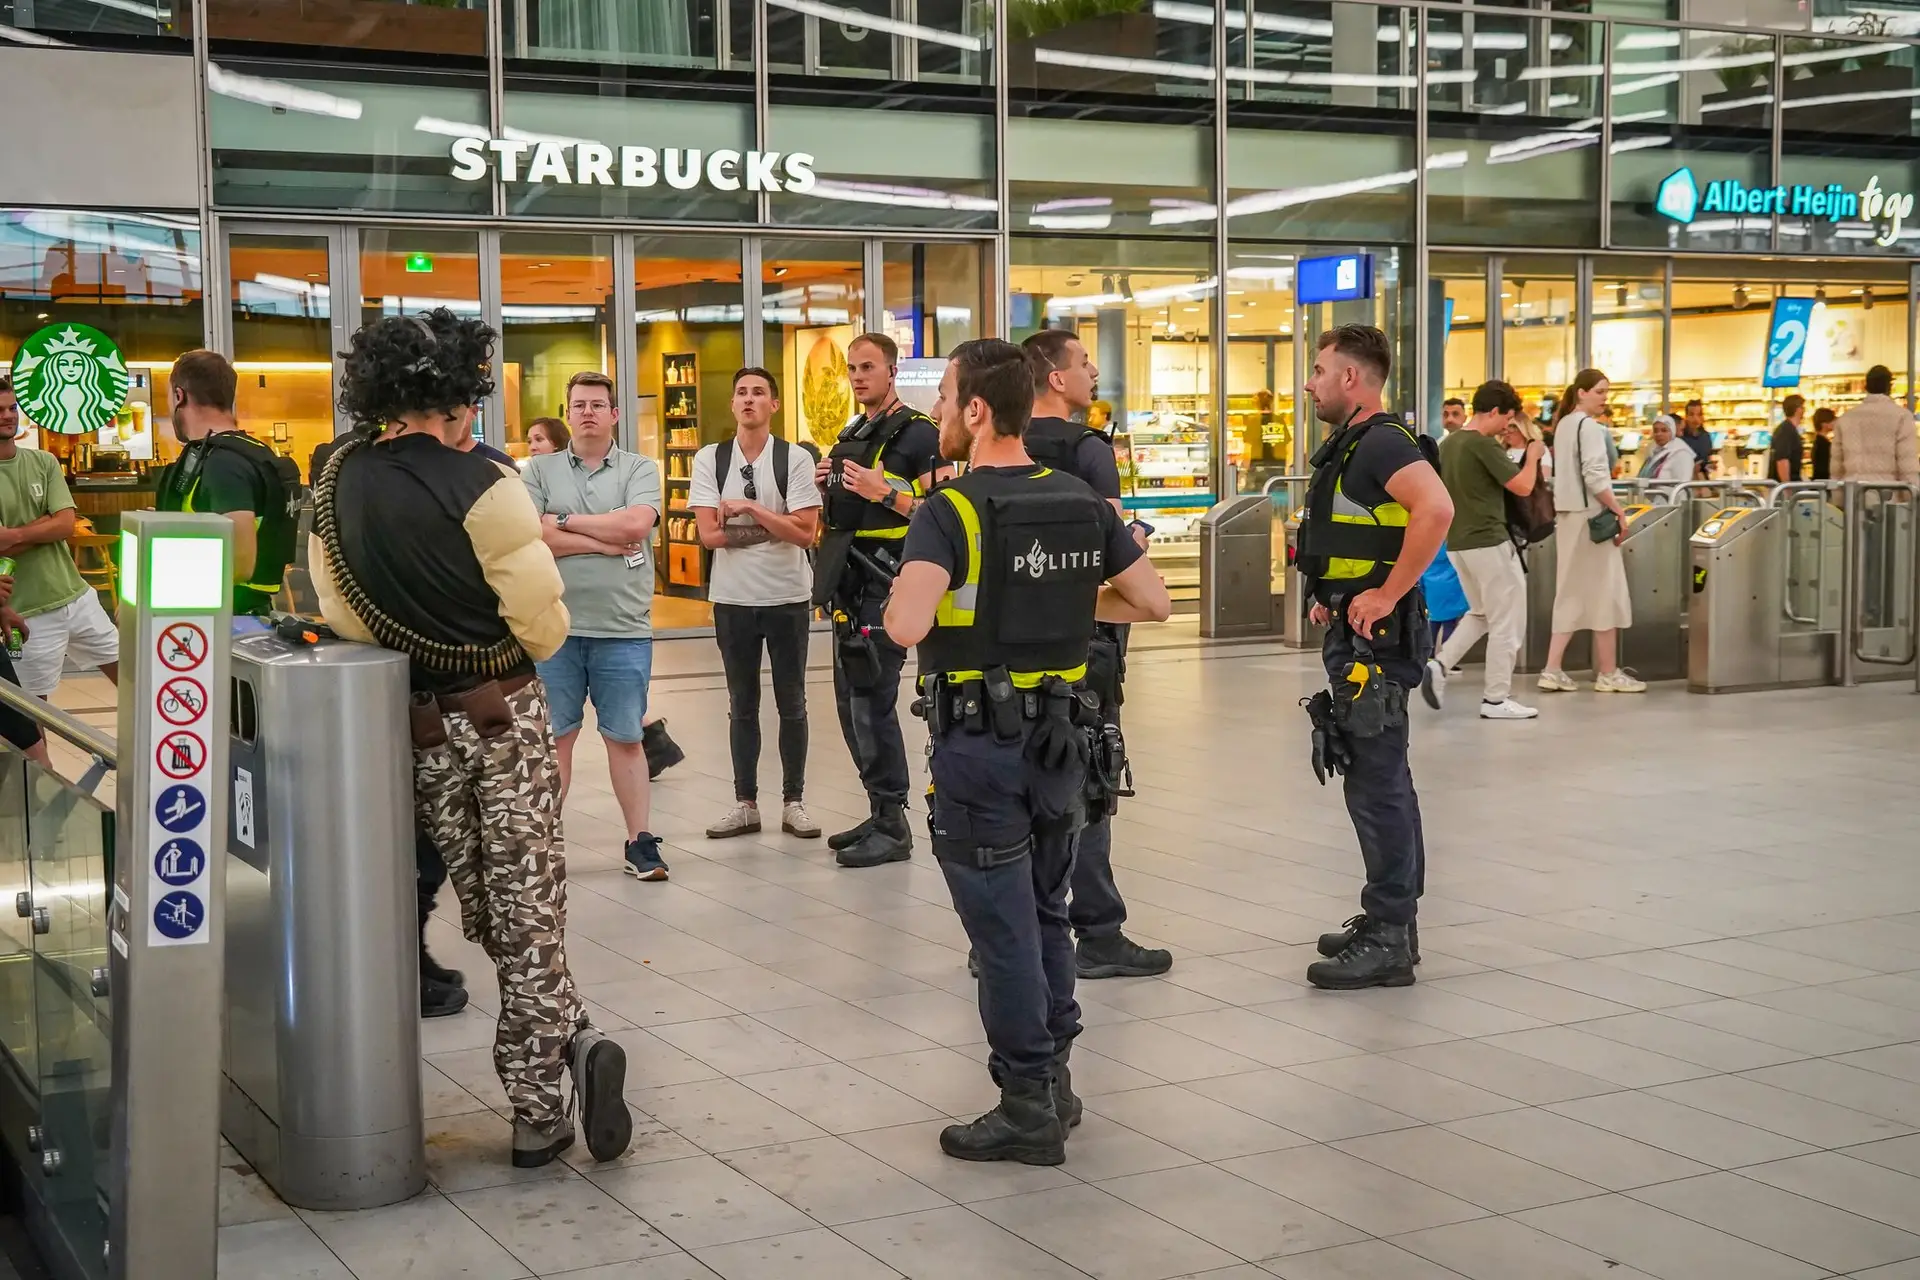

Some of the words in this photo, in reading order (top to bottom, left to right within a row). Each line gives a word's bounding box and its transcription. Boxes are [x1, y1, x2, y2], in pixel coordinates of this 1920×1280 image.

[451, 137, 816, 194] STARBUCKS
[1703, 180, 1787, 215] Albert
[1791, 184, 1858, 222] Heijn
[896, 371, 917, 379] OUW
[1013, 539, 1101, 578] POLITIE
